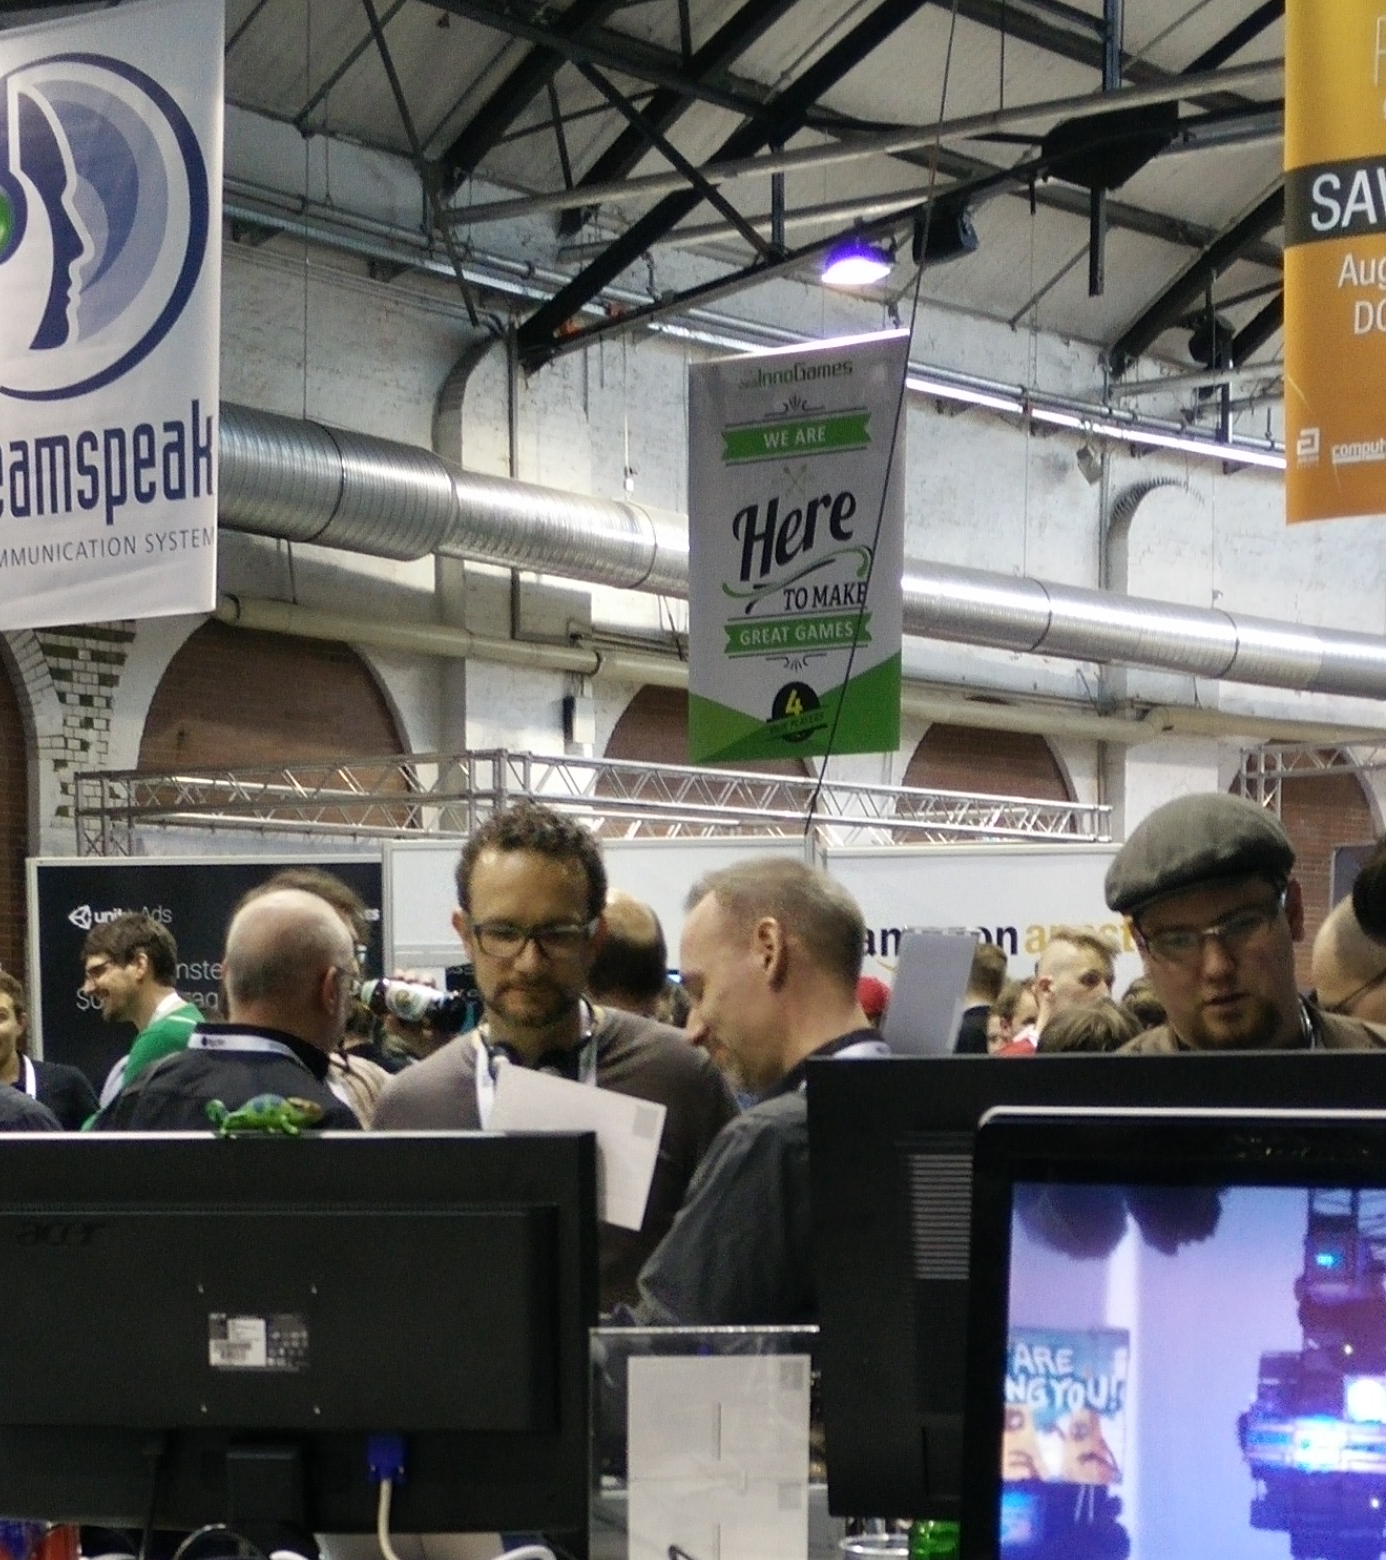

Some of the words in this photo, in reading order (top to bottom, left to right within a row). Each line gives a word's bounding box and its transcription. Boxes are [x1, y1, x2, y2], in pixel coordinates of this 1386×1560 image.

[758, 361, 853, 387] InnoGames
[764, 431, 789, 449] WE
[795, 426, 827, 445] ARE
[732, 490, 857, 582] Here
[783, 587, 809, 611] TO
[813, 581, 868, 608] MAKE
[740, 625, 792, 647] GREAT
[795, 621, 853, 641] GAMES
[785, 688, 804, 717] 4
[1013, 1342, 1073, 1375] ARE
